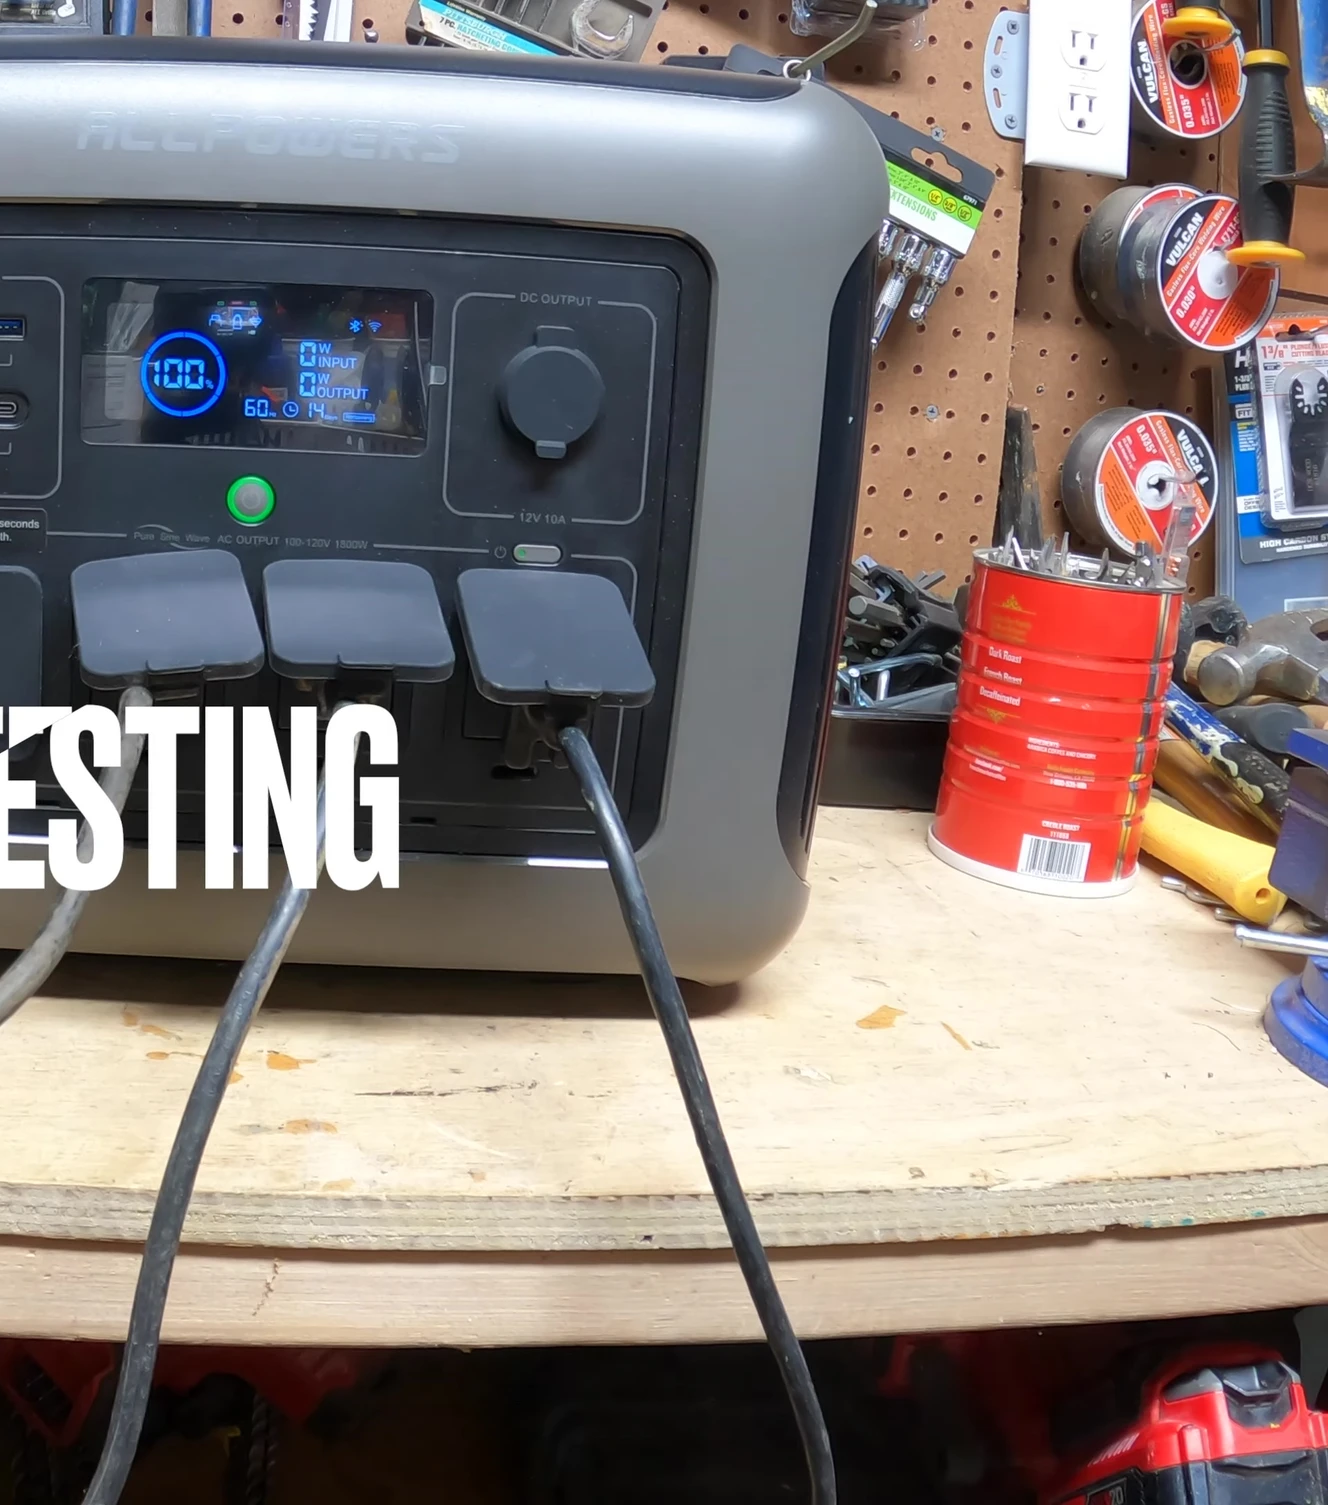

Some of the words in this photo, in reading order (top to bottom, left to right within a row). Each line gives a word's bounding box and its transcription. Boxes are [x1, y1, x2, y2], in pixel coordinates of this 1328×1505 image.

[1148, 14, 1156, 32] Wire
[1137, 39, 1159, 103] VULCAN
[1179, 94, 1195, 128] 0.035"
[76, 111, 466, 164] ALLPOWERS
[1165, 212, 1204, 266] VULCAN
[1166, 272, 1184, 297] Gasless
[1180, 244, 1201, 274] Flux-Core
[1197, 220, 1217, 246] Welding
[1213, 205, 1226, 222] Wire
[520, 291, 538, 303] DC
[541, 293, 592, 306] OUTPUT
[1175, 285, 1196, 318] 0.030"
[300, 341, 316, 367] 0
[318, 343, 331, 354] W
[318, 357, 357, 369] INPUT
[299, 371, 316, 397] 0
[317, 373, 330, 384] W
[317, 387, 369, 400] OUTPUT
[1134, 424, 1158, 456] 0.035"
[1154, 420, 1172, 444] Gasless
[1194, 497, 1207, 513] Wire
[0, 519, 40, 529] seconds
[520, 512, 542, 523] 12V
[545, 514, 566, 524] 10A
[134, 532, 154, 541] Pure
[185, 534, 210, 543] Wave
[217, 535, 232, 545] AC
[236, 535, 279, 546] OUTPUT
[285, 538, 331, 548] 100-120V
[1260, 539, 1282, 549] HIGH
[1283, 534, 1319, 547] CARBON
[989, 646, 1003, 658] Dark
[1003, 650, 1022, 664] Roast
[984, 666, 1002, 680] French
[1003, 672, 1022, 686] Roast
[979, 686, 1020, 707] Decaffeinated
